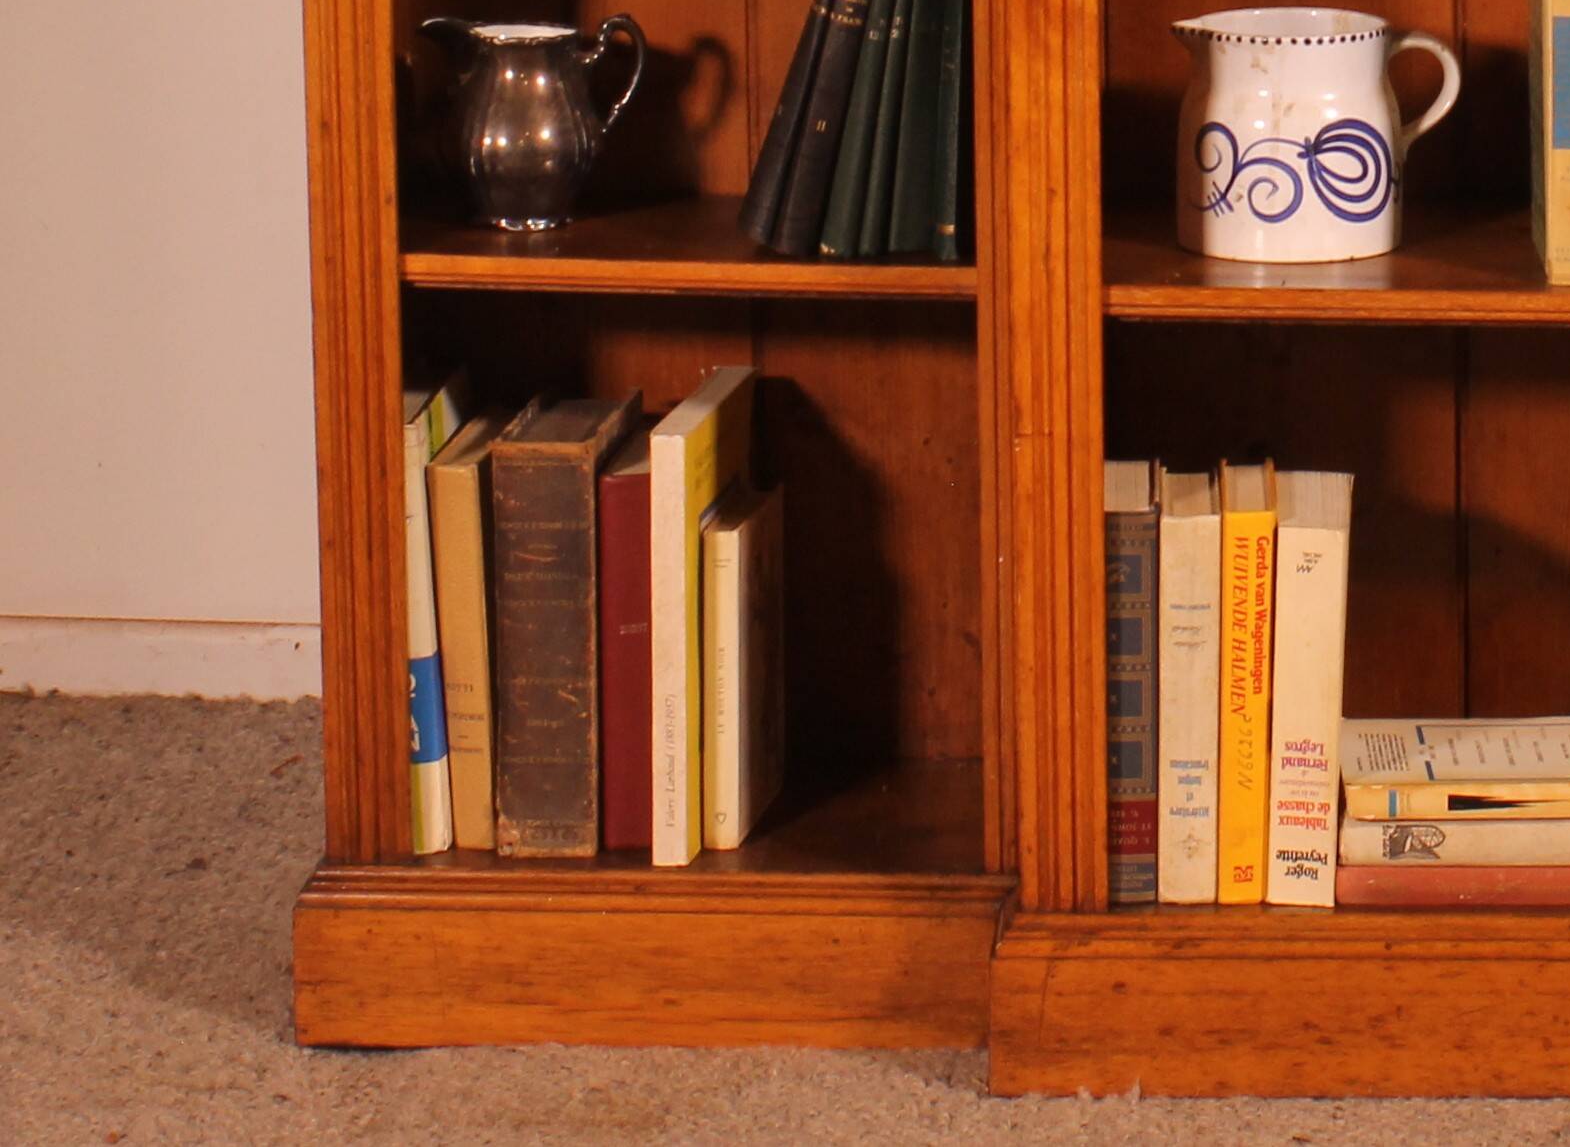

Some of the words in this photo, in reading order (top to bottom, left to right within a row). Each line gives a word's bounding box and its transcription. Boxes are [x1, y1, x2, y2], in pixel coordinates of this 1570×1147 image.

[1255, 535, 1270, 579] Gerda
[1231, 536, 1249, 635] WUIVENDE
[1255, 582, 1265, 606] van
[1250, 608, 1269, 695] Wageningen
[1230, 638, 1247, 716] HALMEN
[1284, 740, 1324, 755] Legros
[1281, 756, 1329, 772] Fernand
[1277, 800, 1314, 814] chasse
[1316, 802, 1330, 815] de
[1278, 815, 1329, 831] Tableaux
[1276, 849, 1328, 866] Peyrefitte
[1284, 865, 1319, 880] Roger
